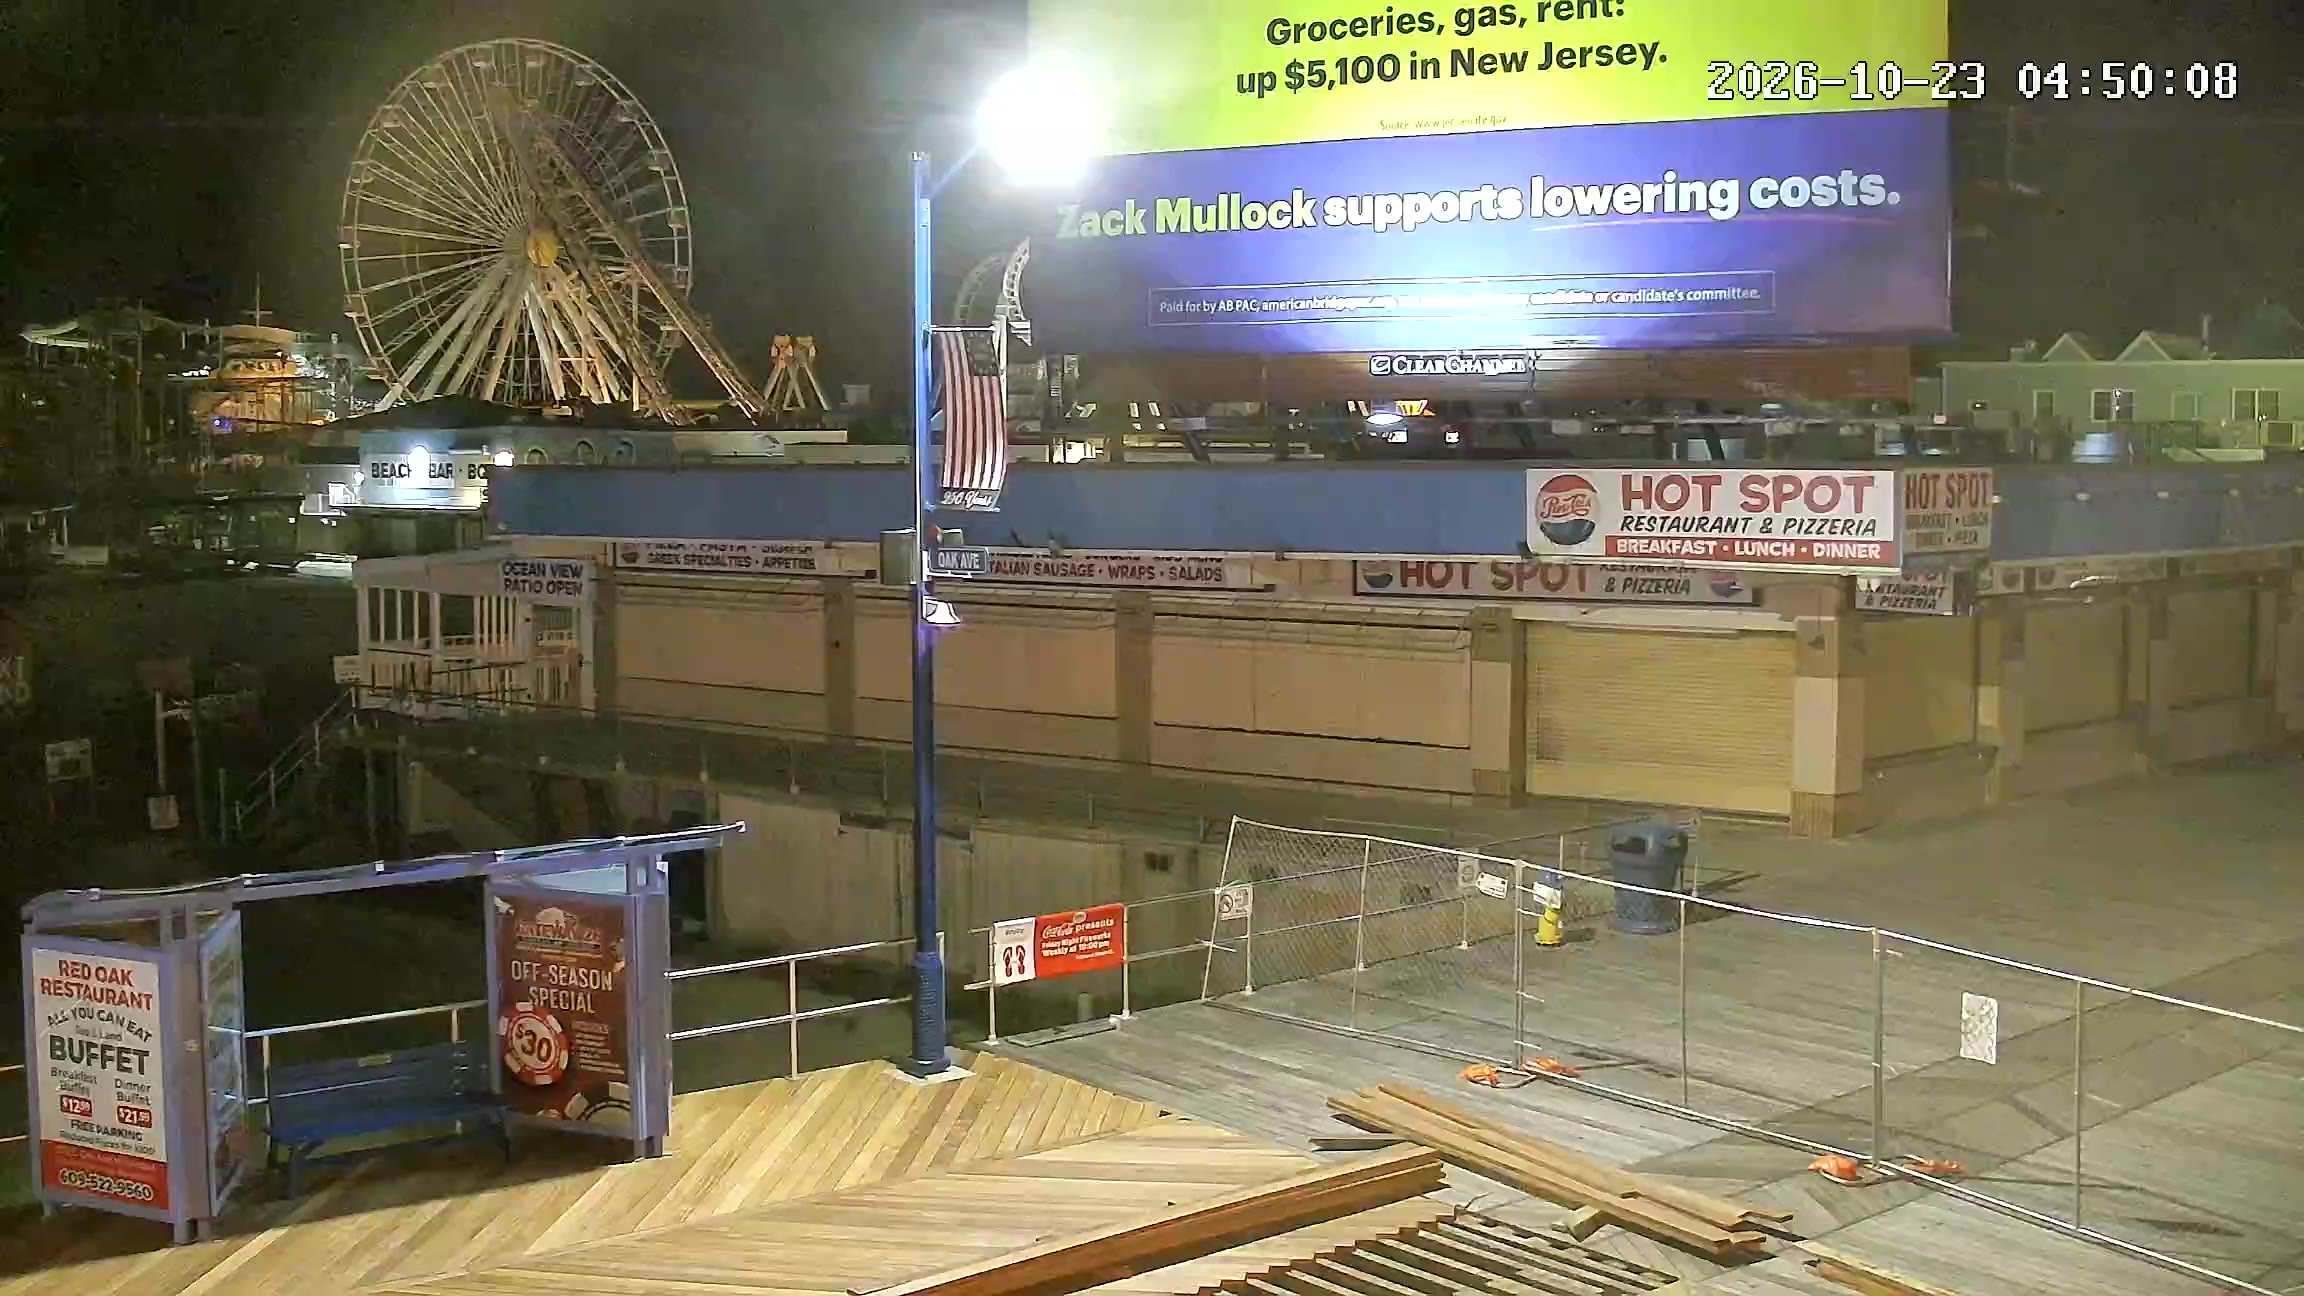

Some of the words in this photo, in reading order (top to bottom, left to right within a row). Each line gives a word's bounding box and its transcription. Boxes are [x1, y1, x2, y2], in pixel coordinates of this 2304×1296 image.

[1266, 7, 1446, 45] Groceries,
[1454, 2, 1528, 38] gas,
[1537, 0, 1625, 23] rent:
[1236, 69, 1277, 98] up
[1285, 54, 1400, 93] $5,100
[1410, 50, 1441, 80] in
[1450, 47, 1529, 76] New
[1538, 40, 1668, 71] Jersey.
[1056, 199, 1148, 239] Zack
[1155, 187, 1318, 234] Mullock
[1322, 184, 1524, 233] supports
[1530, 170, 1741, 221] lowering
[1749, 169, 1901, 209] costs.
[1159, 301, 1183, 313] Paid
[1202, 300, 1217, 314] by
[1217, 299, 1235, 312] AB
[1621, 474, 1723, 512] HOT
[1740, 474, 1876, 514] SPOT
[1905, 473, 1942, 509] HOT
[1945, 473, 1991, 509] SPOT
[1620, 514, 1755, 535] RESTAURANT
[1760, 515, 1773, 535] &
[1783, 517, 1877, 537] PIZZERIA
[938, 551, 960, 568] OAK
[960, 551, 980, 569] AVE
[1616, 537, 1717, 556] BREAKFAST
[1735, 540, 1795, 557] LUNCH
[1813, 542, 1881, 559] DINNER
[503, 562, 546, 577] OCEAN
[550, 563, 584, 578] VIEW
[1034, 560, 1095, 578] SAUSAGE
[1107, 564, 1155, 581] WRAPS
[1168, 566, 1223, 583] SALADS
[1401, 561, 1482, 589] HOT
[1491, 561, 1590, 592] SPOT
[504, 578, 543, 595] PATIO
[546, 579, 583, 597] OPEN
[1604, 577, 1616, 593] &
[1621, 577, 1691, 595] PIZZERIA
[1880, 595, 1937, 610] PIZZERIA
[1075, 918, 1114, 934] presents
[59, 960, 92, 980] RED
[95, 966, 135, 987] OAK
[511, 960, 613, 992] OFF-SEASON
[40, 978, 153, 1011] RESTAURANT
[527, 985, 597, 1015] SPECIAL
[47, 1009, 70, 1027] ALL
[70, 1007, 95, 1020] YOU
[96, 1009, 126, 1028] CAN
[126, 1020, 153, 1043] EAT
[49, 1034, 150, 1076] BUFFET
[514, 1023, 553, 1063] $30
[114, 1078, 151, 1093] Dinner
[116, 1091, 151, 1106] Buffet
[71, 1119, 95, 1133] FREE
[96, 1122, 144, 1141] PARKING
